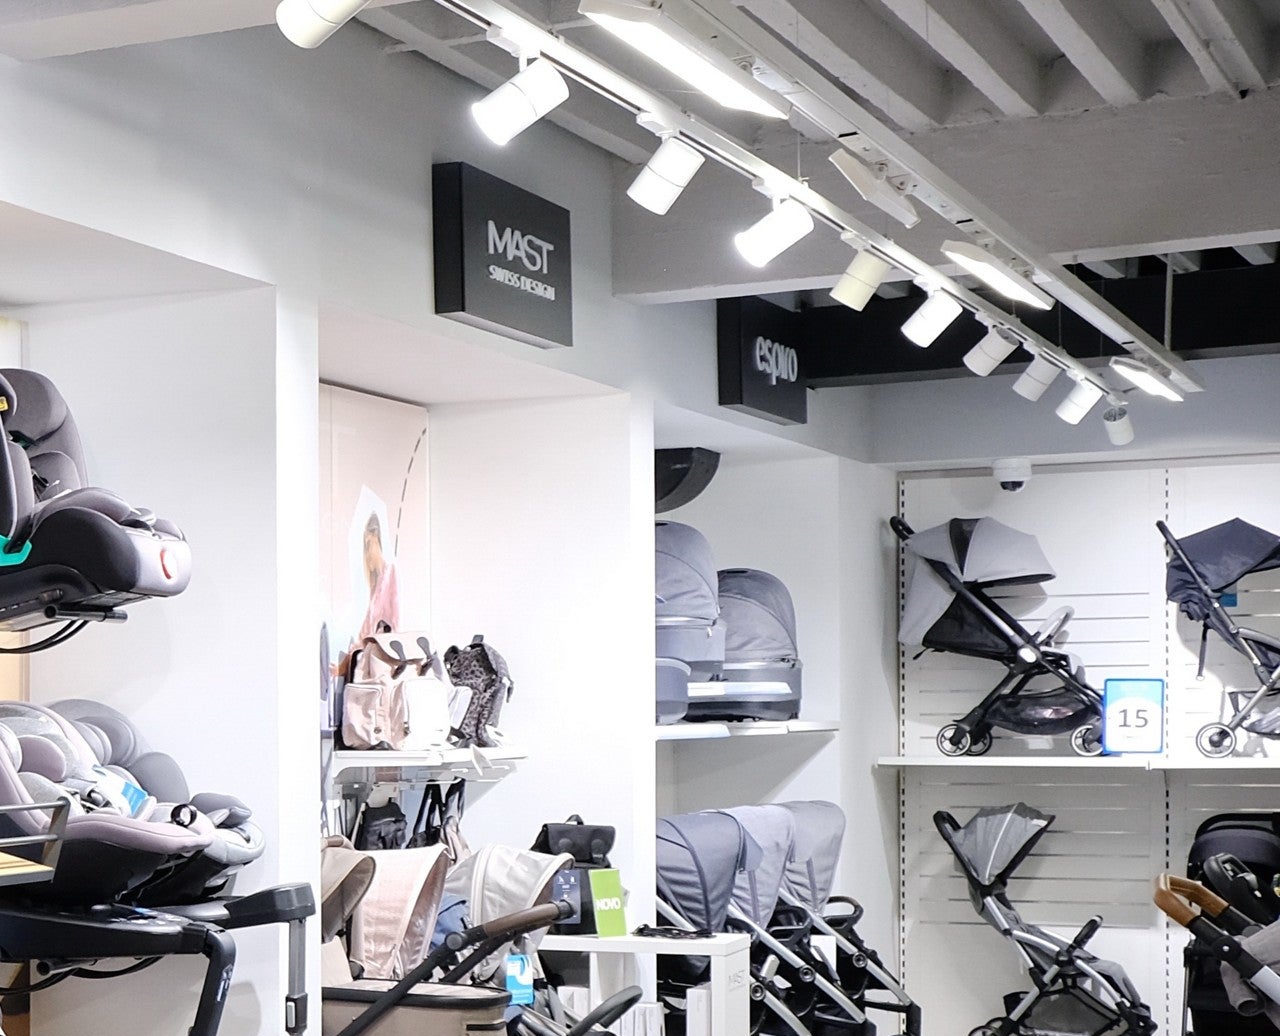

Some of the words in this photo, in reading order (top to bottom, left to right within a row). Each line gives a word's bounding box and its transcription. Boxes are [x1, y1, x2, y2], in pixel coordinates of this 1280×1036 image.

[487, 219, 555, 274] MAST
[488, 265, 520, 288] SWISS
[520, 275, 556, 301] DESIGN
[1118, 708, 1149, 728] 15
